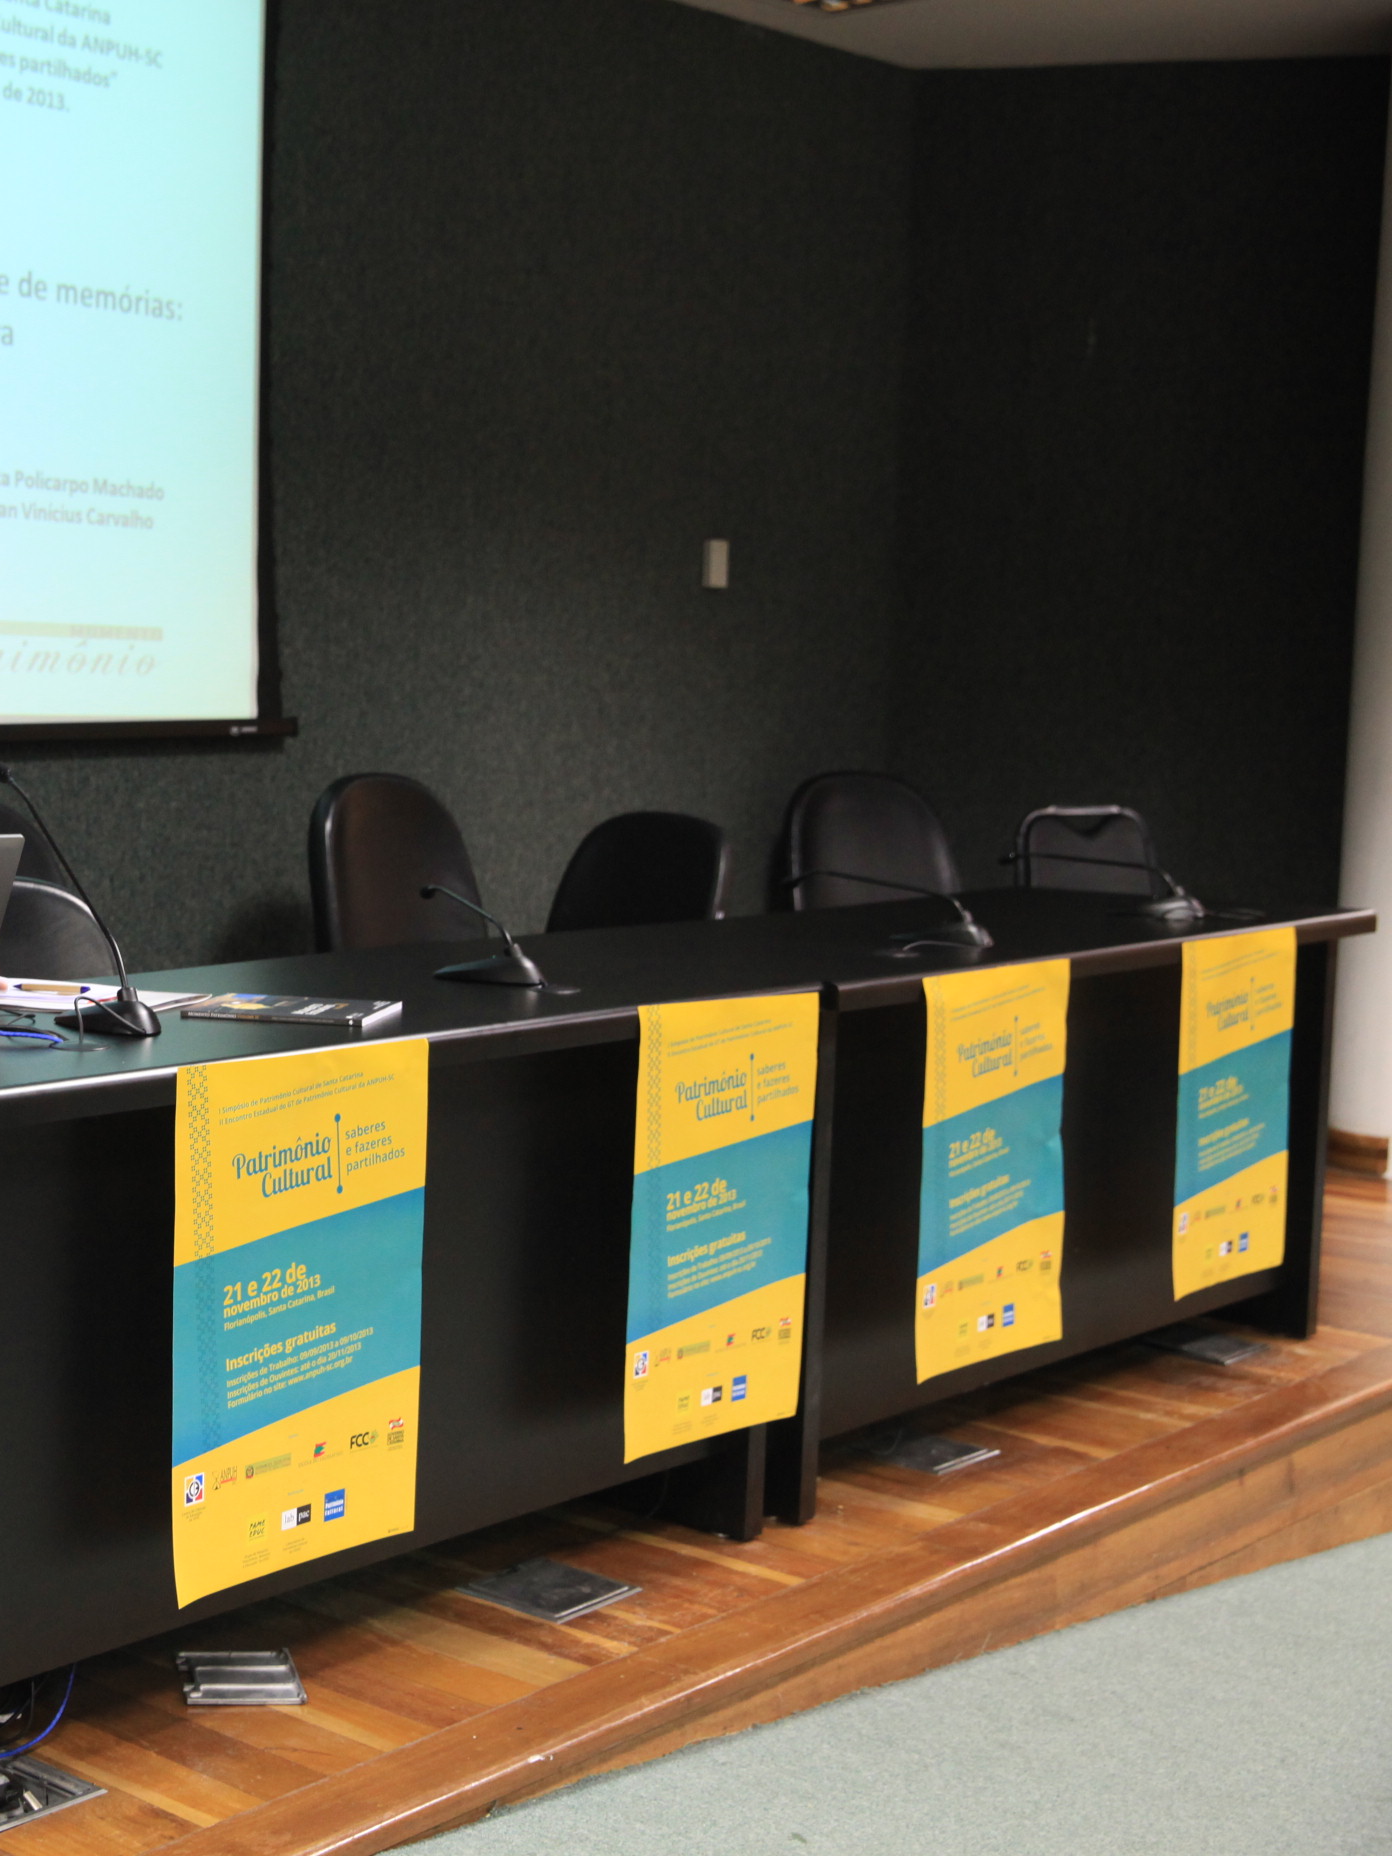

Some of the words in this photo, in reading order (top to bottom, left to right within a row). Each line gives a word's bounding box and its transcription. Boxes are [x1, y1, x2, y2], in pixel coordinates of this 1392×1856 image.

[57, 27, 77, 49] da
[81, 33, 163, 69] ANPUH-SC
[2, 80, 23, 102] de
[26, 86, 70, 113] 2013.
[18, 270, 47, 301] de
[56, 284, 182, 321] memórias:
[14, 471, 89, 498] Policarpo
[92, 478, 164, 501] Machado
[86, 507, 155, 530] Carvalho
[675, 1069, 747, 1104] Patrimônio
[696, 1089, 748, 1121] Cultural
[345, 1121, 386, 1140] saberes
[346, 1147, 352, 1156] e
[355, 1136, 393, 1154] fazeres
[232, 1132, 332, 1180] Patrimônio
[346, 1147, 406, 1176] partilhados
[262, 1156, 333, 1198] Cultural
[667, 1191, 680, 1210] 21
[684, 1191, 692, 1204] e
[695, 1182, 709, 1201] 22
[711, 1178, 727, 1196] de
[224, 1282, 242, 1306] 21
[248, 1281, 258, 1297] e
[262, 1269, 282, 1293] 22
[286, 1262, 307, 1284] de
[224, 1291, 279, 1319] novembro
[281, 1284, 294, 1298] de
[296, 1274, 321, 1294] 2013
[226, 1342, 283, 1372] Inscrições
[285, 1323, 337, 1354] gratuitas
[350, 1431, 369, 1450] FCC
